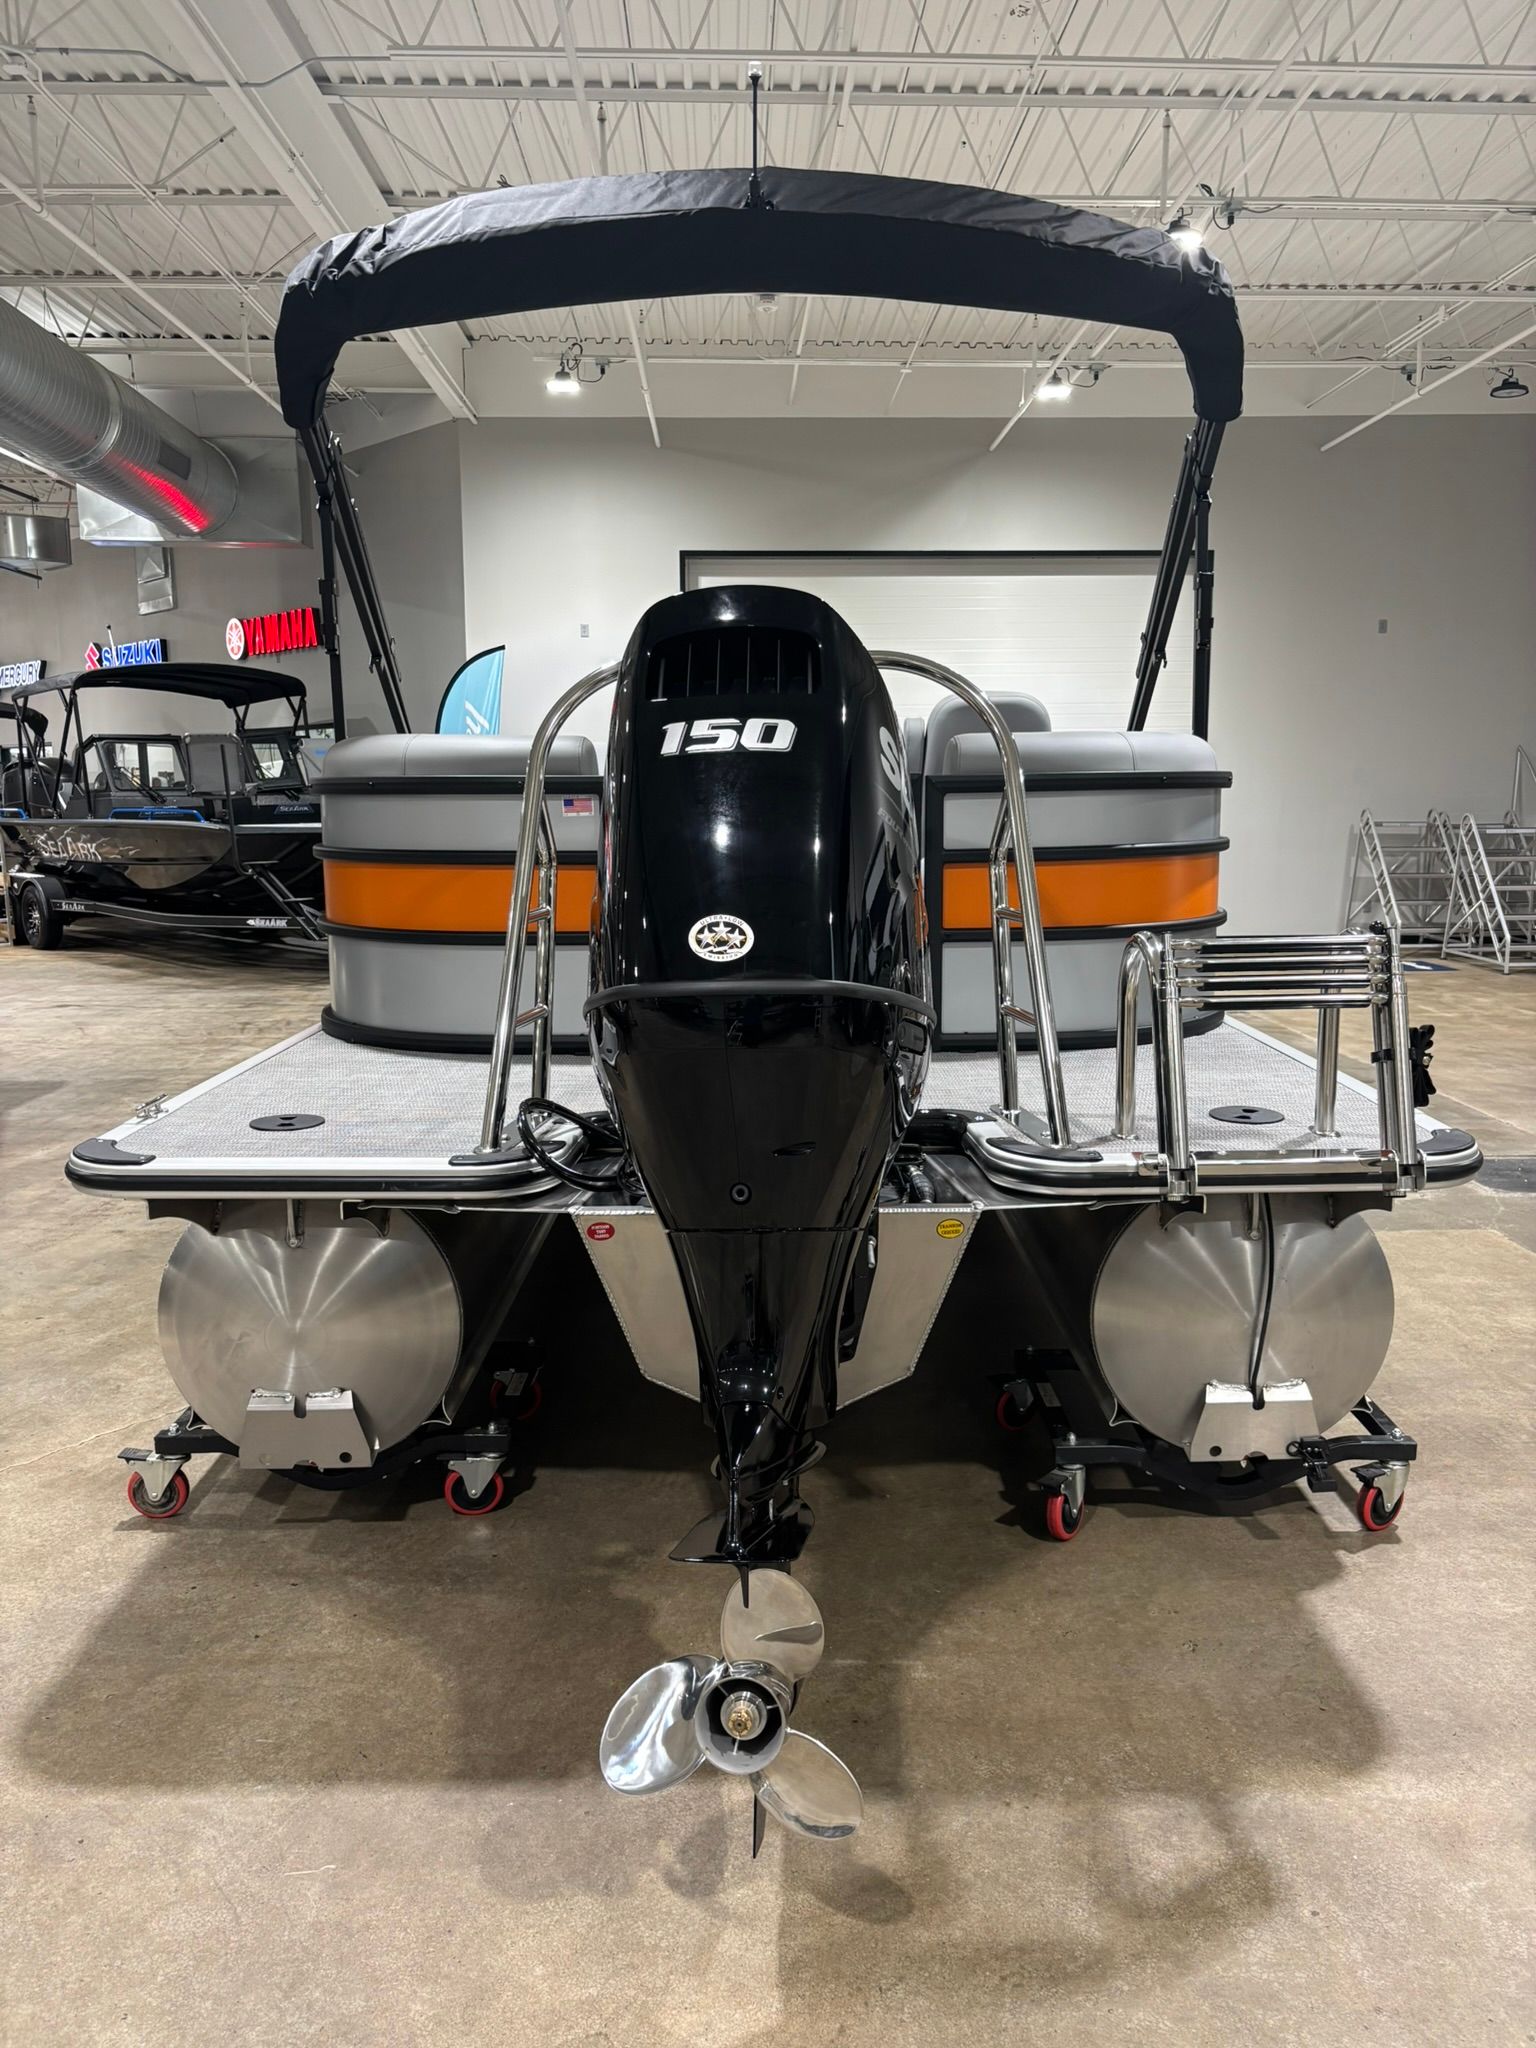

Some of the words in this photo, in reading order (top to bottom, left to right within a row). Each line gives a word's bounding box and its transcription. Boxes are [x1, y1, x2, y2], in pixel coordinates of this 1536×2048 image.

[242, 606, 318, 656] YAMAHA
[102, 638, 162, 667] SUZUKI
[660, 717, 798, 757] 150
